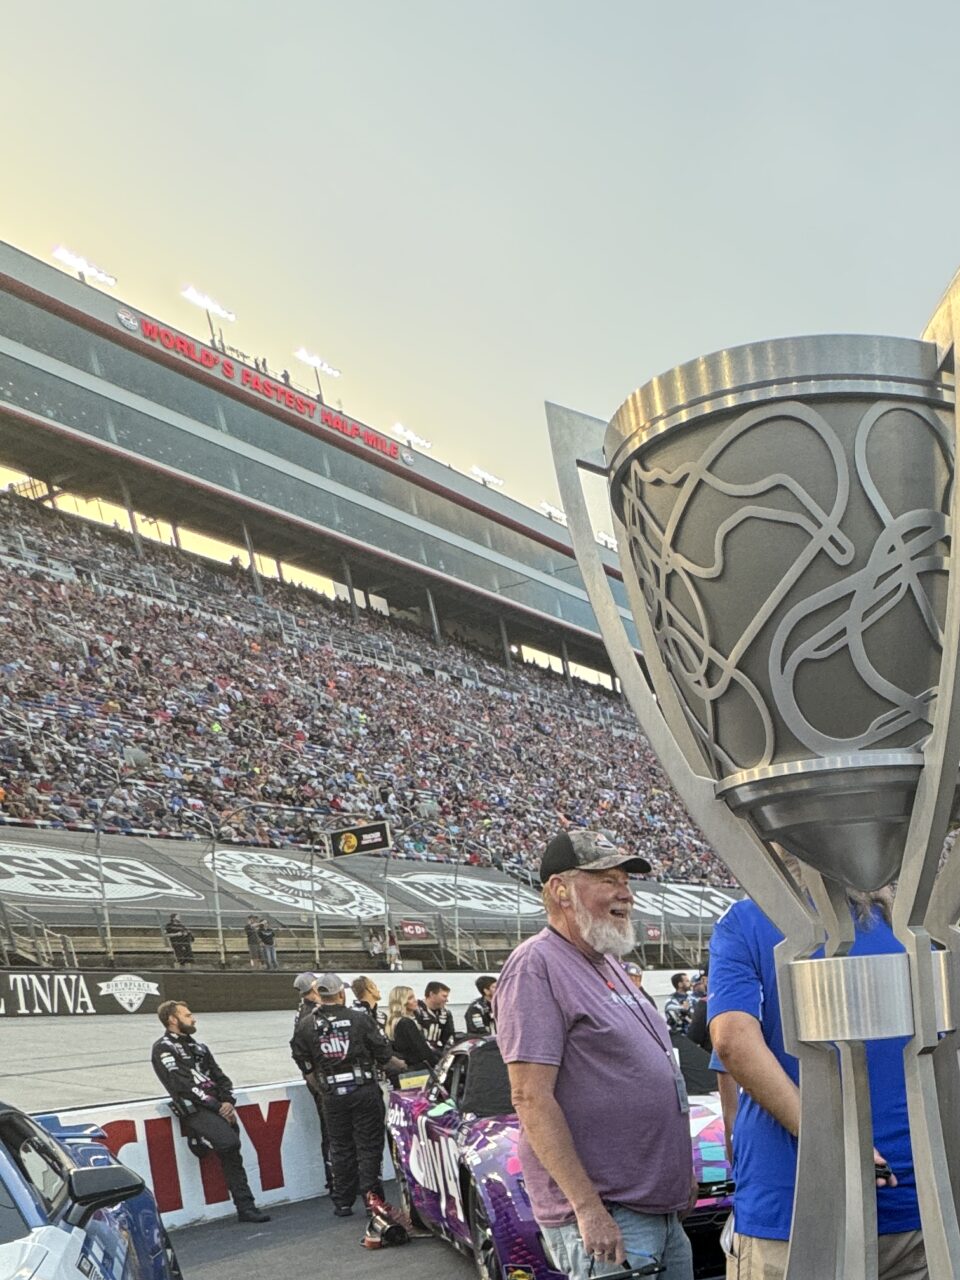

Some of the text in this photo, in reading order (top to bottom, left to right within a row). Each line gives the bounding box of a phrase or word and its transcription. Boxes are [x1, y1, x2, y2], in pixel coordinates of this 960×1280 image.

[140, 318, 399, 459] WORLD'S FASTEST HALF-MILE
[9, 974, 96, 1014] TN/VA
[320, 1037, 350, 1061] ally
